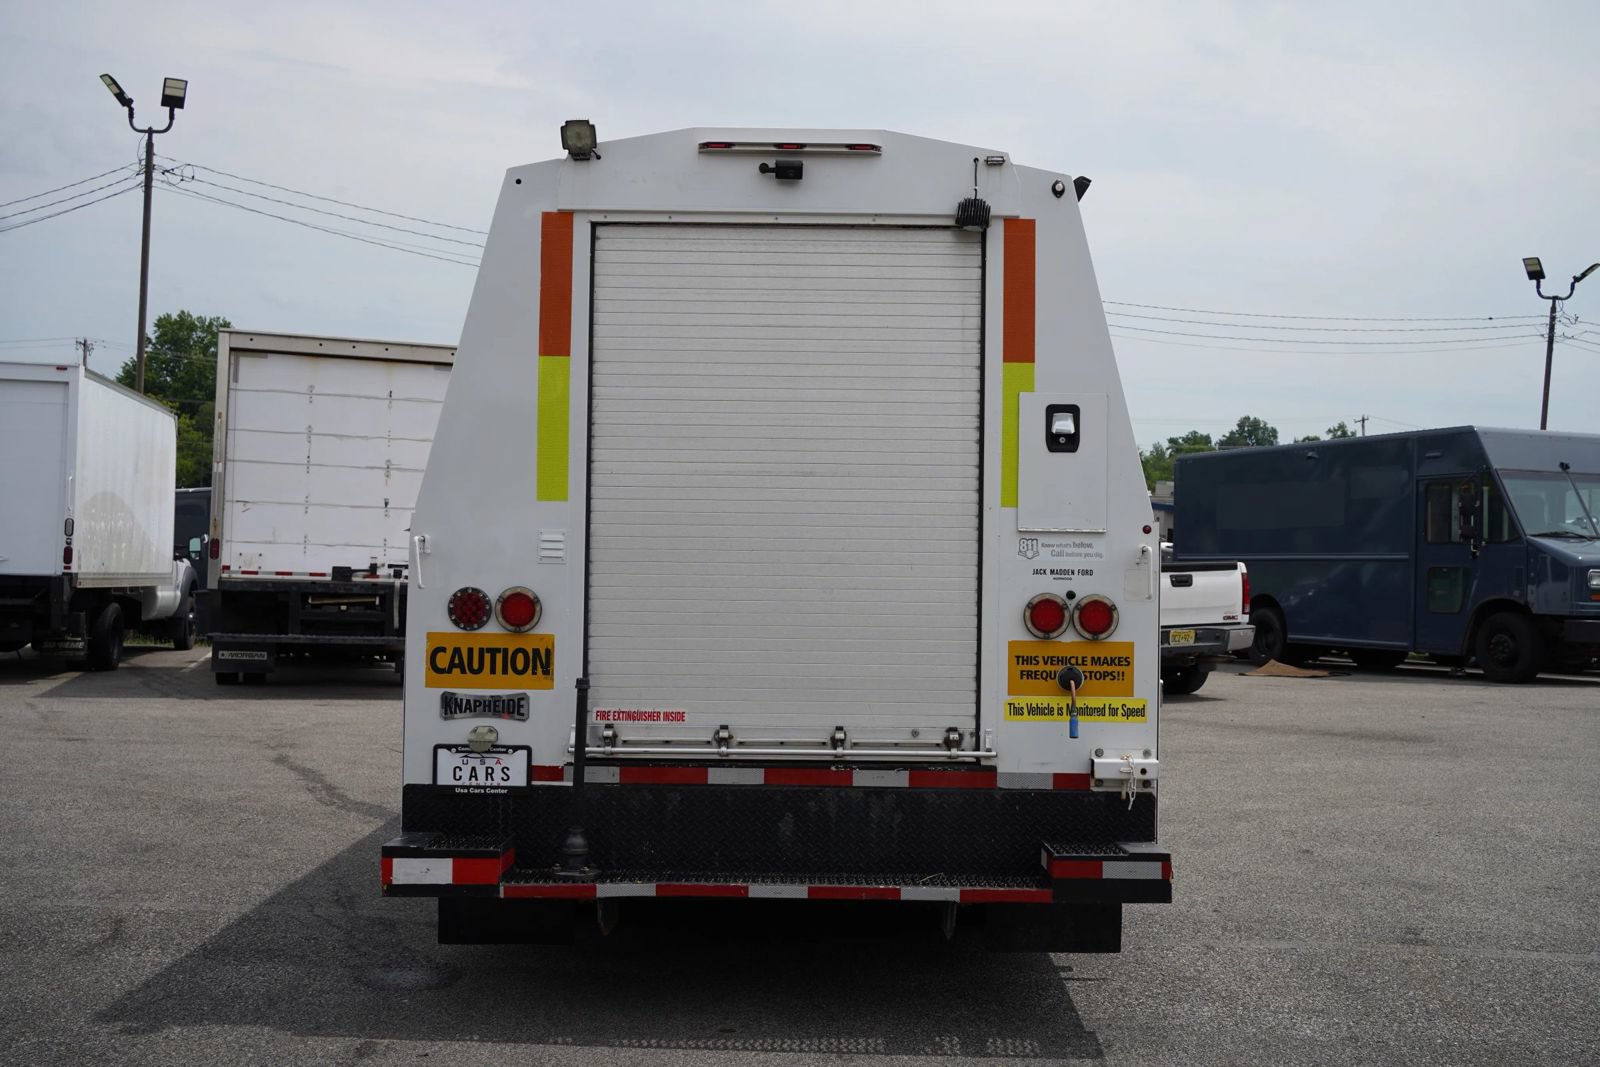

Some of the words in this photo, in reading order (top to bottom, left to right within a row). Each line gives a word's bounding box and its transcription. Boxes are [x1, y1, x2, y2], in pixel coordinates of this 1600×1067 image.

[1019, 538, 1038, 552] 811
[1072, 541, 1094, 549] below.
[429, 646, 551, 676] CAUTION
[1015, 655, 1040, 666] THIS
[1042, 656, 1088, 667] VEHICLE
[1090, 656, 1131, 667] MAKES
[1020, 670, 1059, 681] FREQU
[1082, 671, 1125, 681] STOPS!!
[443, 696, 526, 717] KNAPHEIDE
[1008, 703, 1025, 717] This
[1026, 703, 1054, 717] Vehicle
[1057, 704, 1064, 716] is
[1108, 704, 1119, 717] for
[1121, 704, 1145, 720] Speed
[595, 710, 611, 721] FIRE
[612, 710, 661, 722] EXTINGUISHER
[662, 711, 686, 722] INSIDE
[453, 766, 510, 782] CARS
